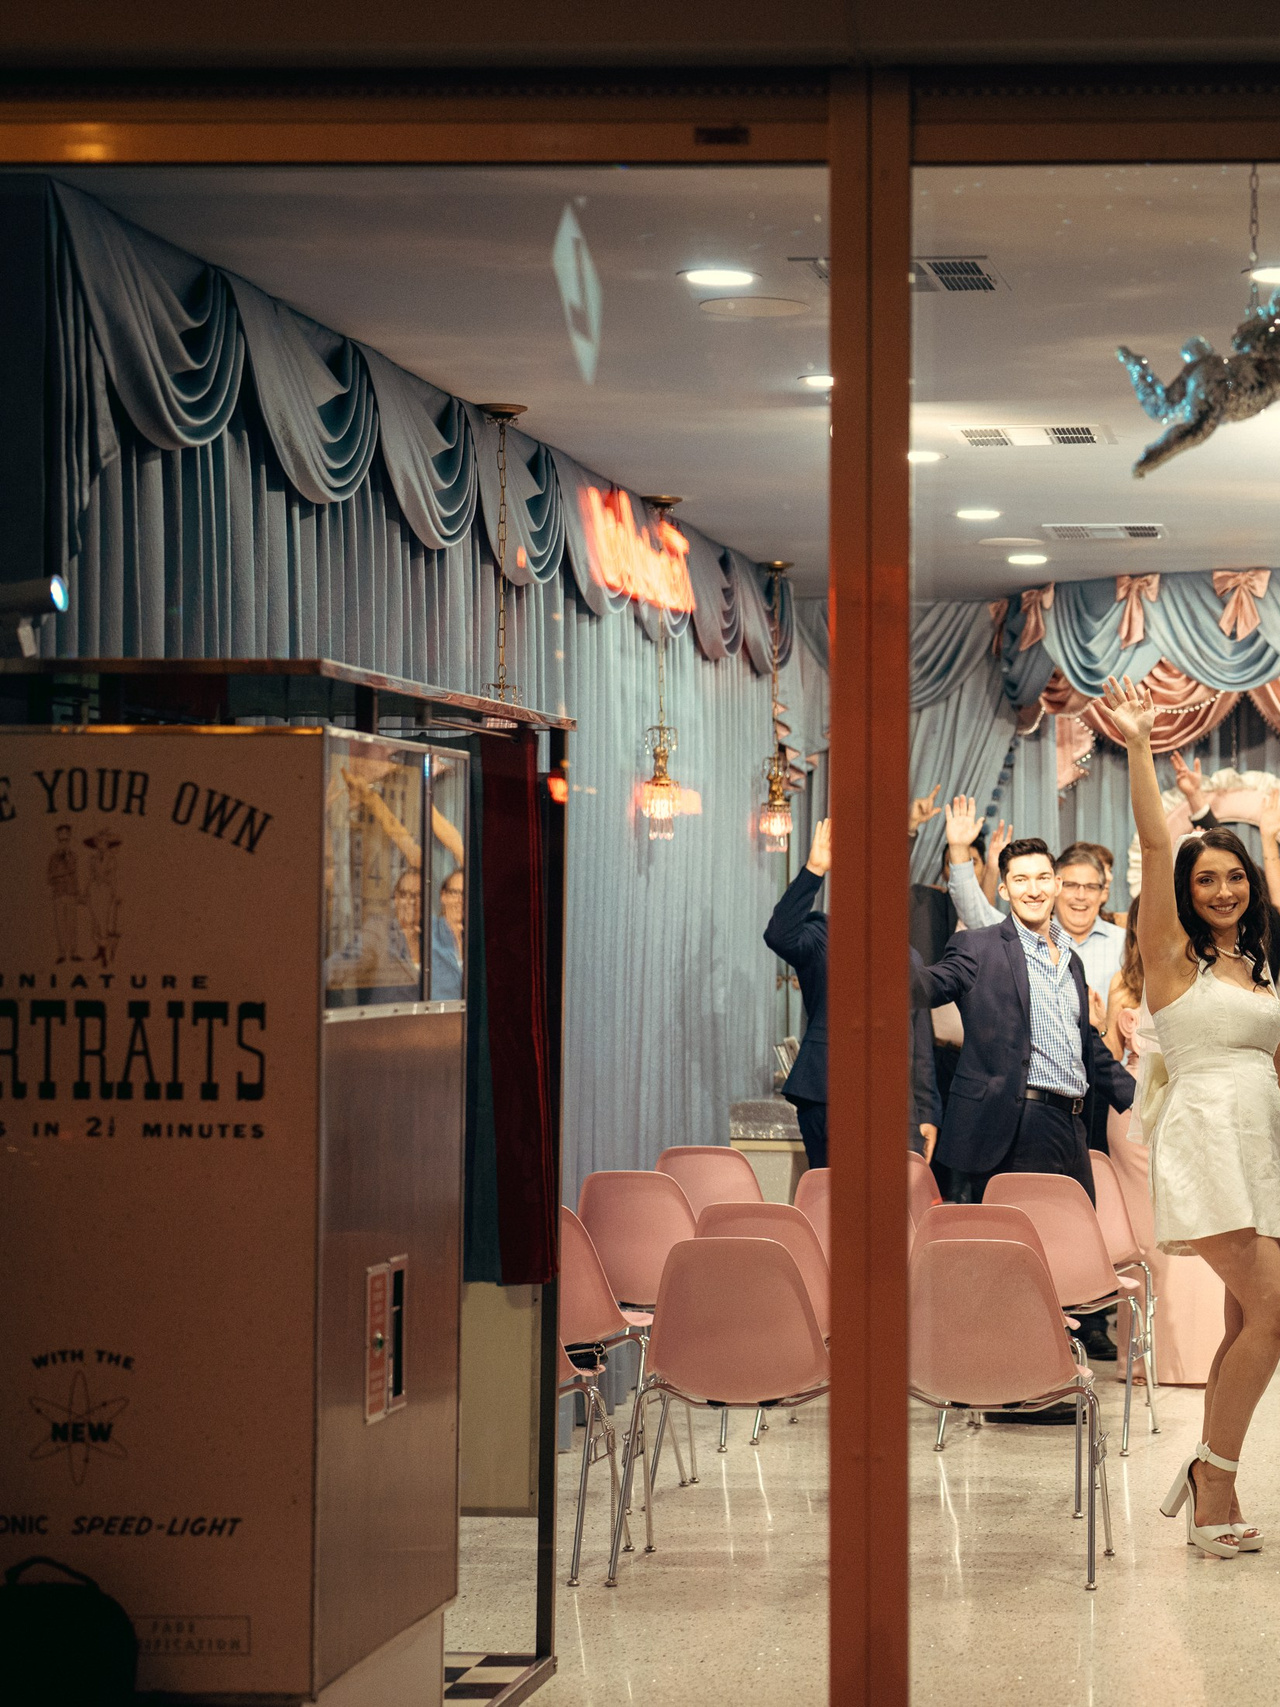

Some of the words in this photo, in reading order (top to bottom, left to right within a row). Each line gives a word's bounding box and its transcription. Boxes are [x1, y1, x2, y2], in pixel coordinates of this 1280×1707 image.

[33, 767, 151, 817] YOUR
[171, 780, 274, 855] OWN
[0, 1000, 267, 1101] RTRAITS
[32, 1122, 60, 1138] IN
[142, 1123, 266, 1139] MINUTES
[31, 1349, 84, 1369] WITH
[95, 1350, 135, 1370] THE
[51, 1421, 113, 1443] NEW
[71, 1515, 242, 1537] SPEED-LIGHT
